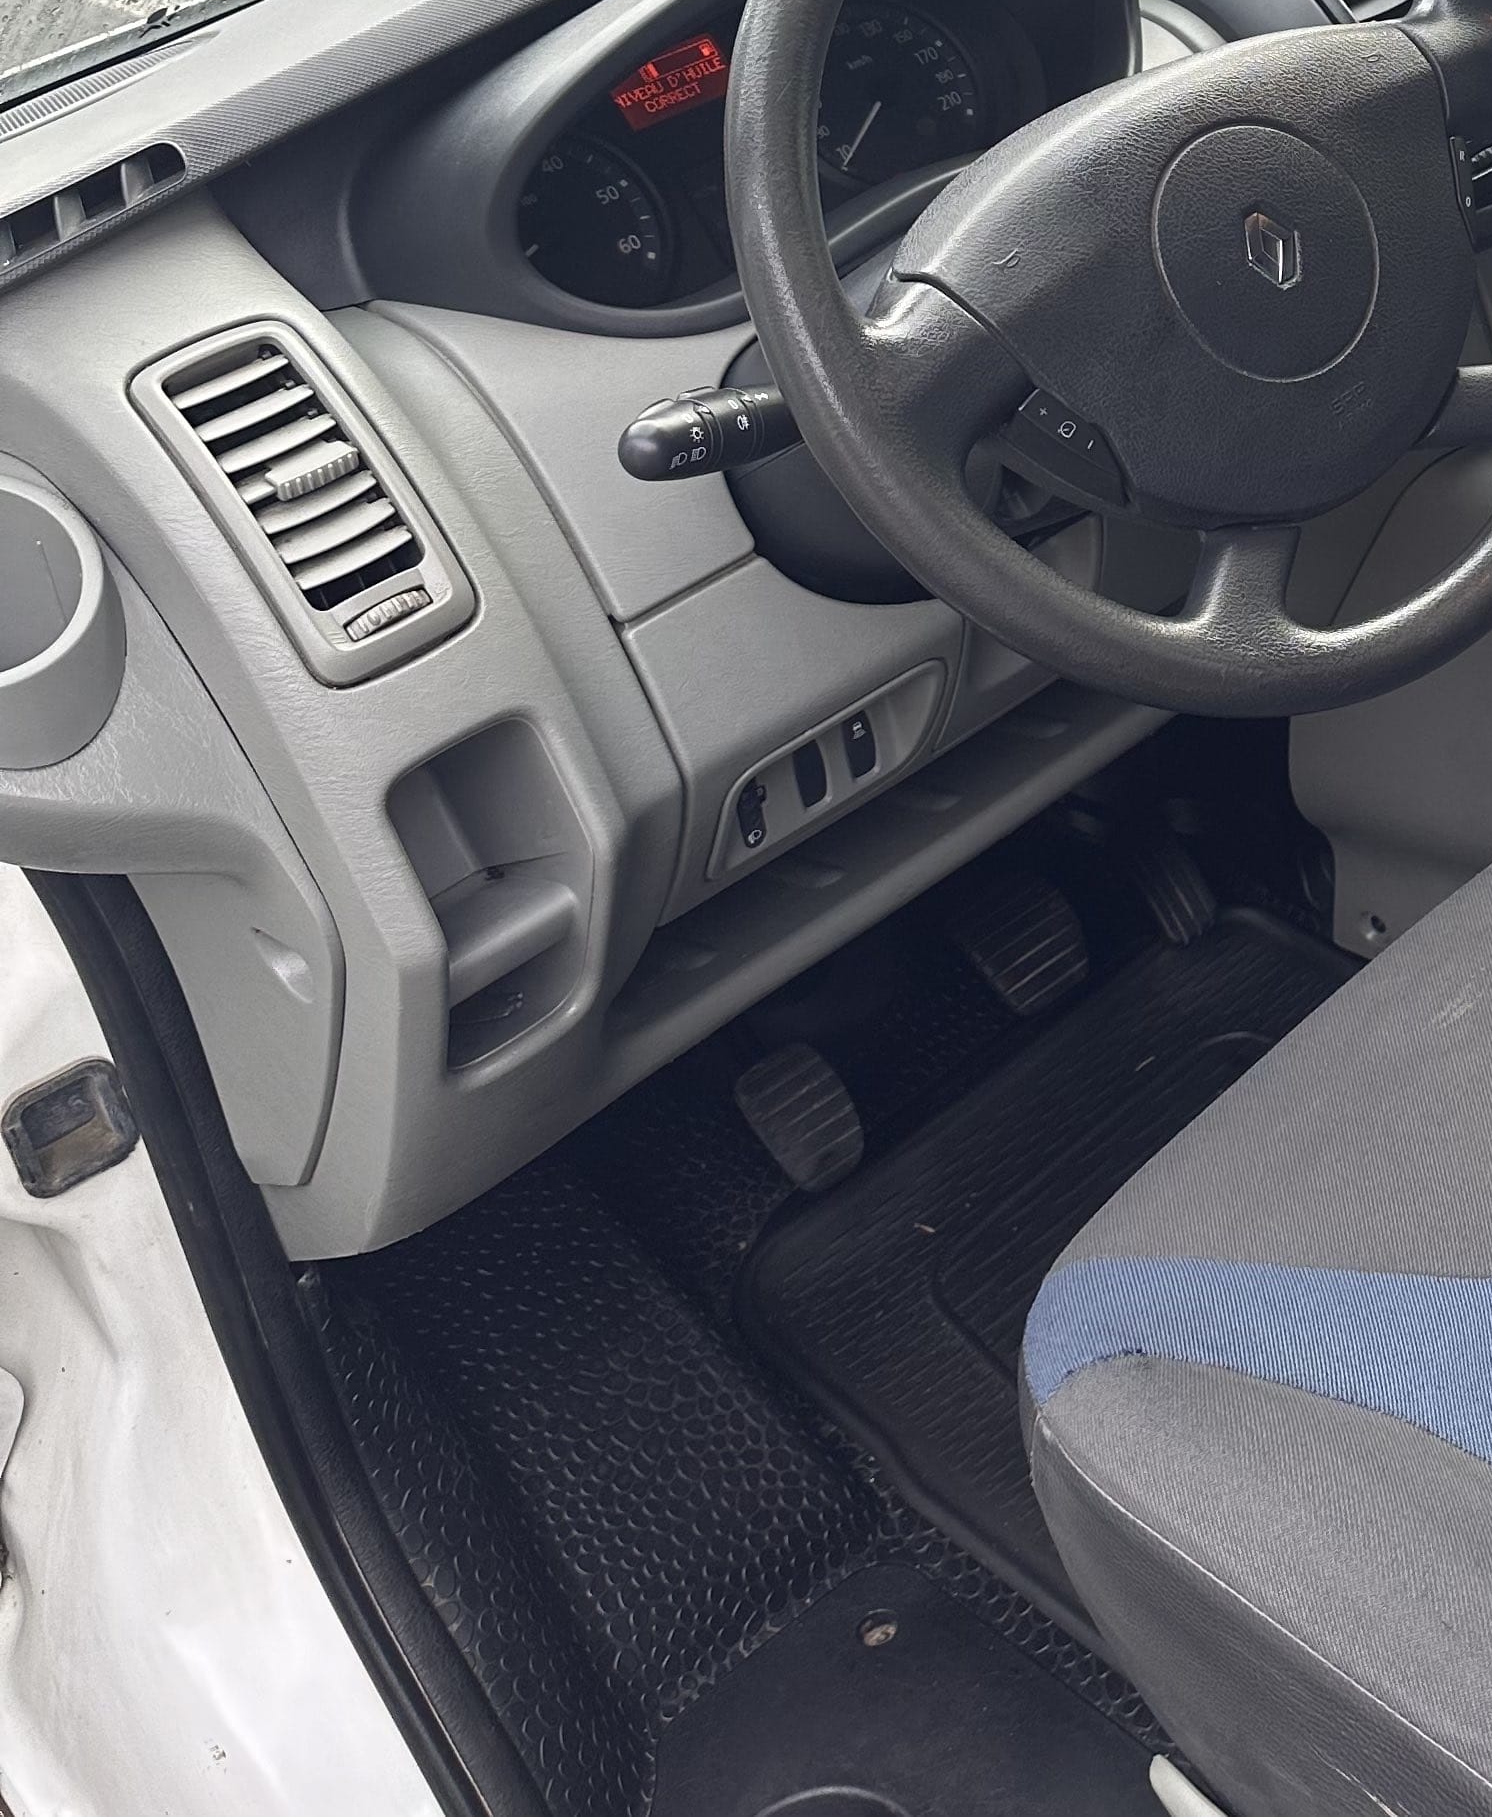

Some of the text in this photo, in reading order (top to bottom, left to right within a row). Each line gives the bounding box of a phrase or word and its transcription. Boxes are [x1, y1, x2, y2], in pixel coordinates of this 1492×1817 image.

[914, 46, 939, 65] 170
[666, 57, 727, 88] D'HUILE
[644, 82, 702, 113] CORRECT
[937, 91, 962, 111] 210
[542, 155, 564, 173] 40
[595, 185, 620, 205] 50
[618, 235, 641, 254] 60
